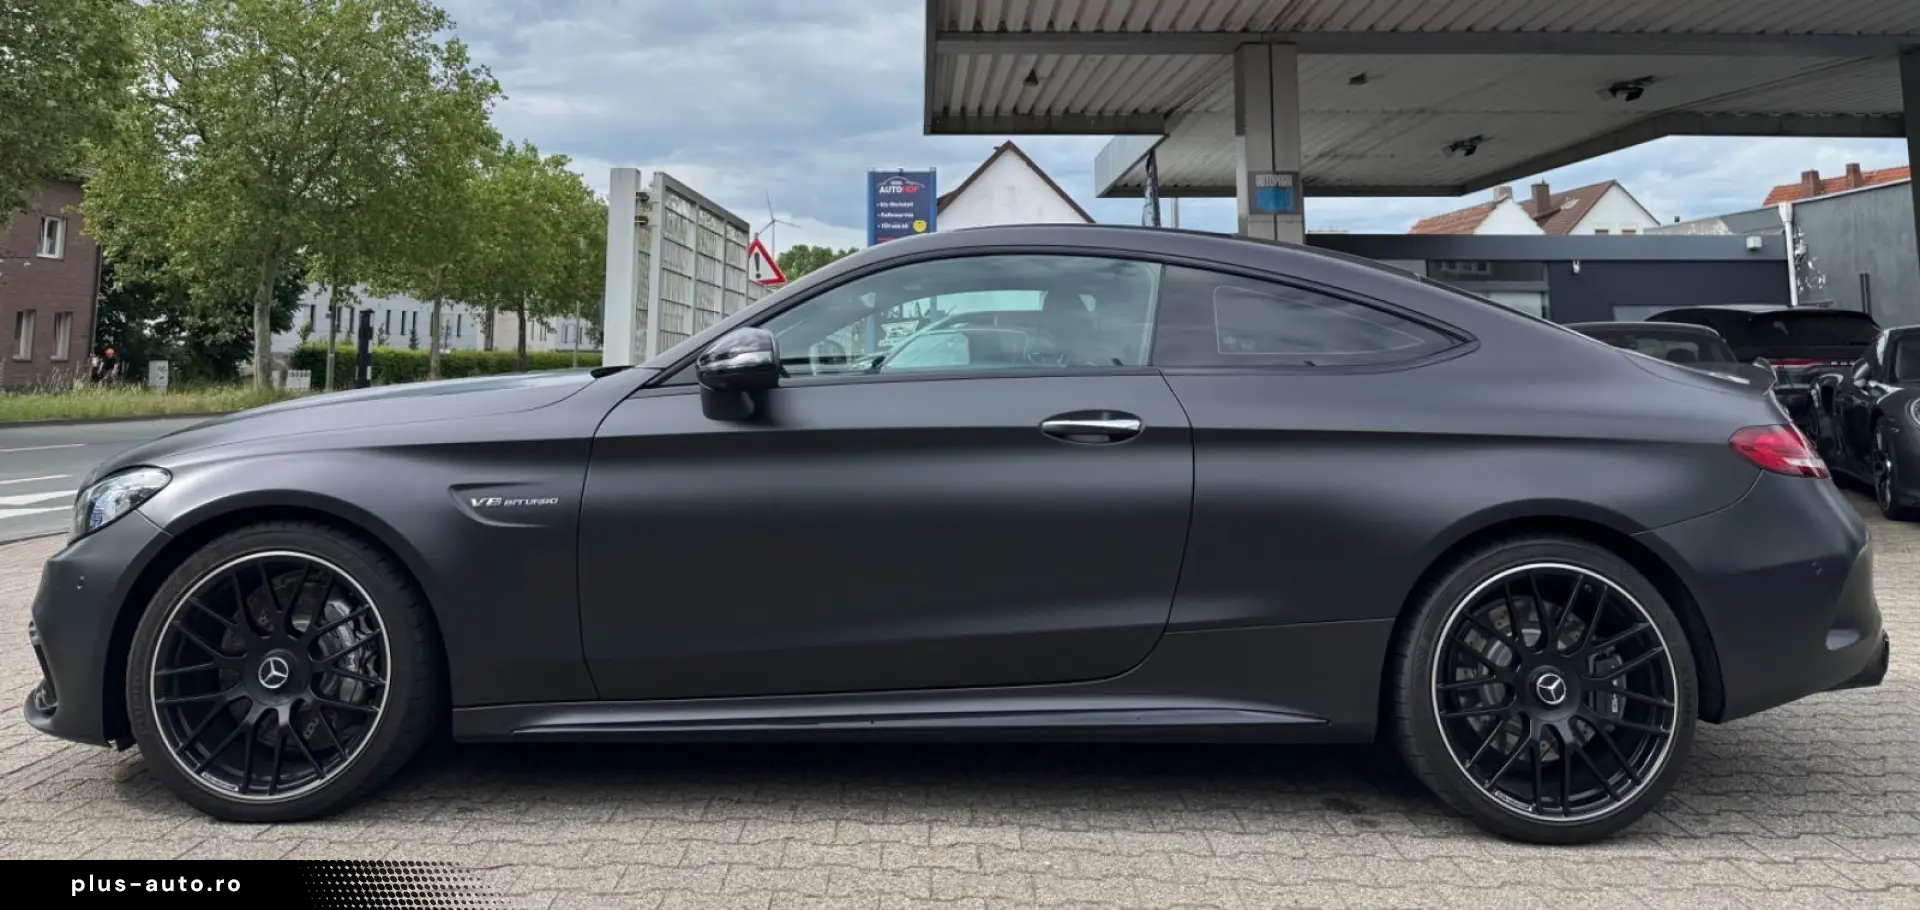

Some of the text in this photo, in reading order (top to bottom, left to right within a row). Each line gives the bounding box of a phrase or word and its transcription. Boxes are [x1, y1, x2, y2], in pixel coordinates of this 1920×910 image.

[879, 185, 919, 193] AUTOHOF
[471, 497, 558, 507] V8 BITURBO
